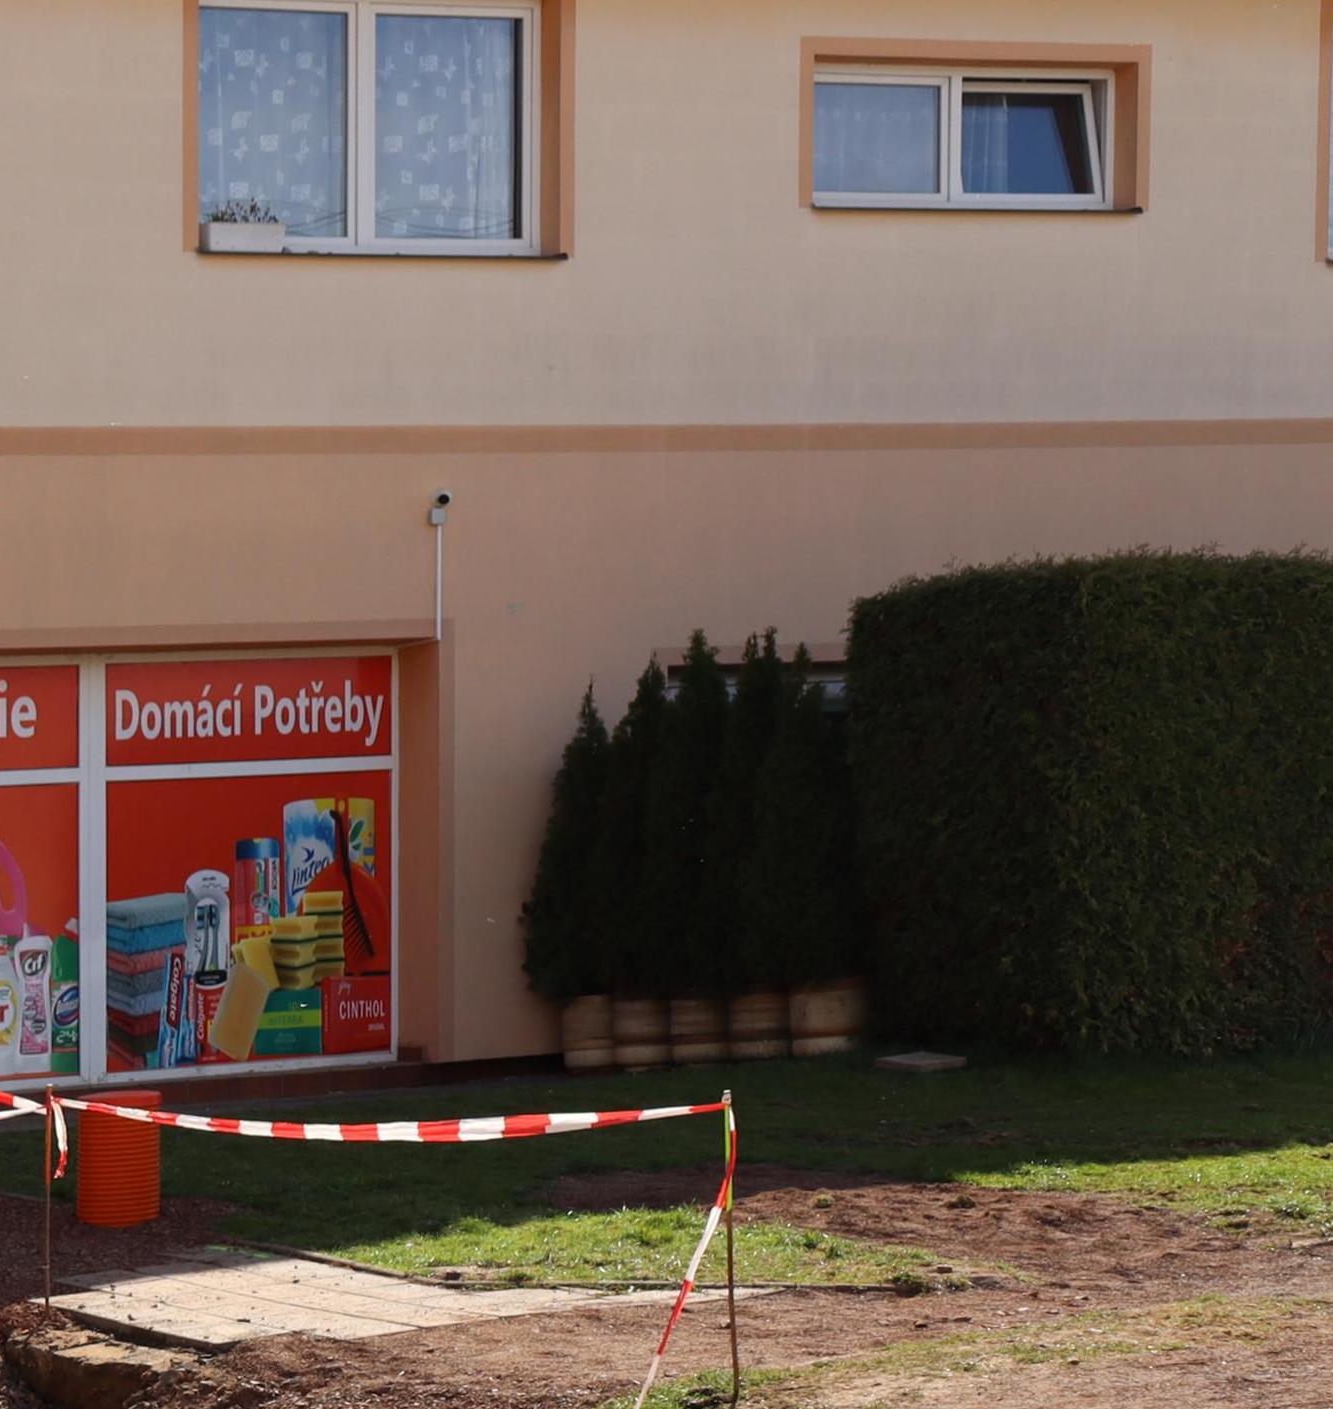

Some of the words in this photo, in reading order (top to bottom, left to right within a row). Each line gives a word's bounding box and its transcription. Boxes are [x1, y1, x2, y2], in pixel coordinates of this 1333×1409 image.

[114, 683, 244, 741] Domácí
[254, 679, 384, 747] Potřeby
[24, 953, 43, 973] Cif
[169, 957, 182, 1021] Colgate
[339, 999, 386, 1020] CINTHOL
